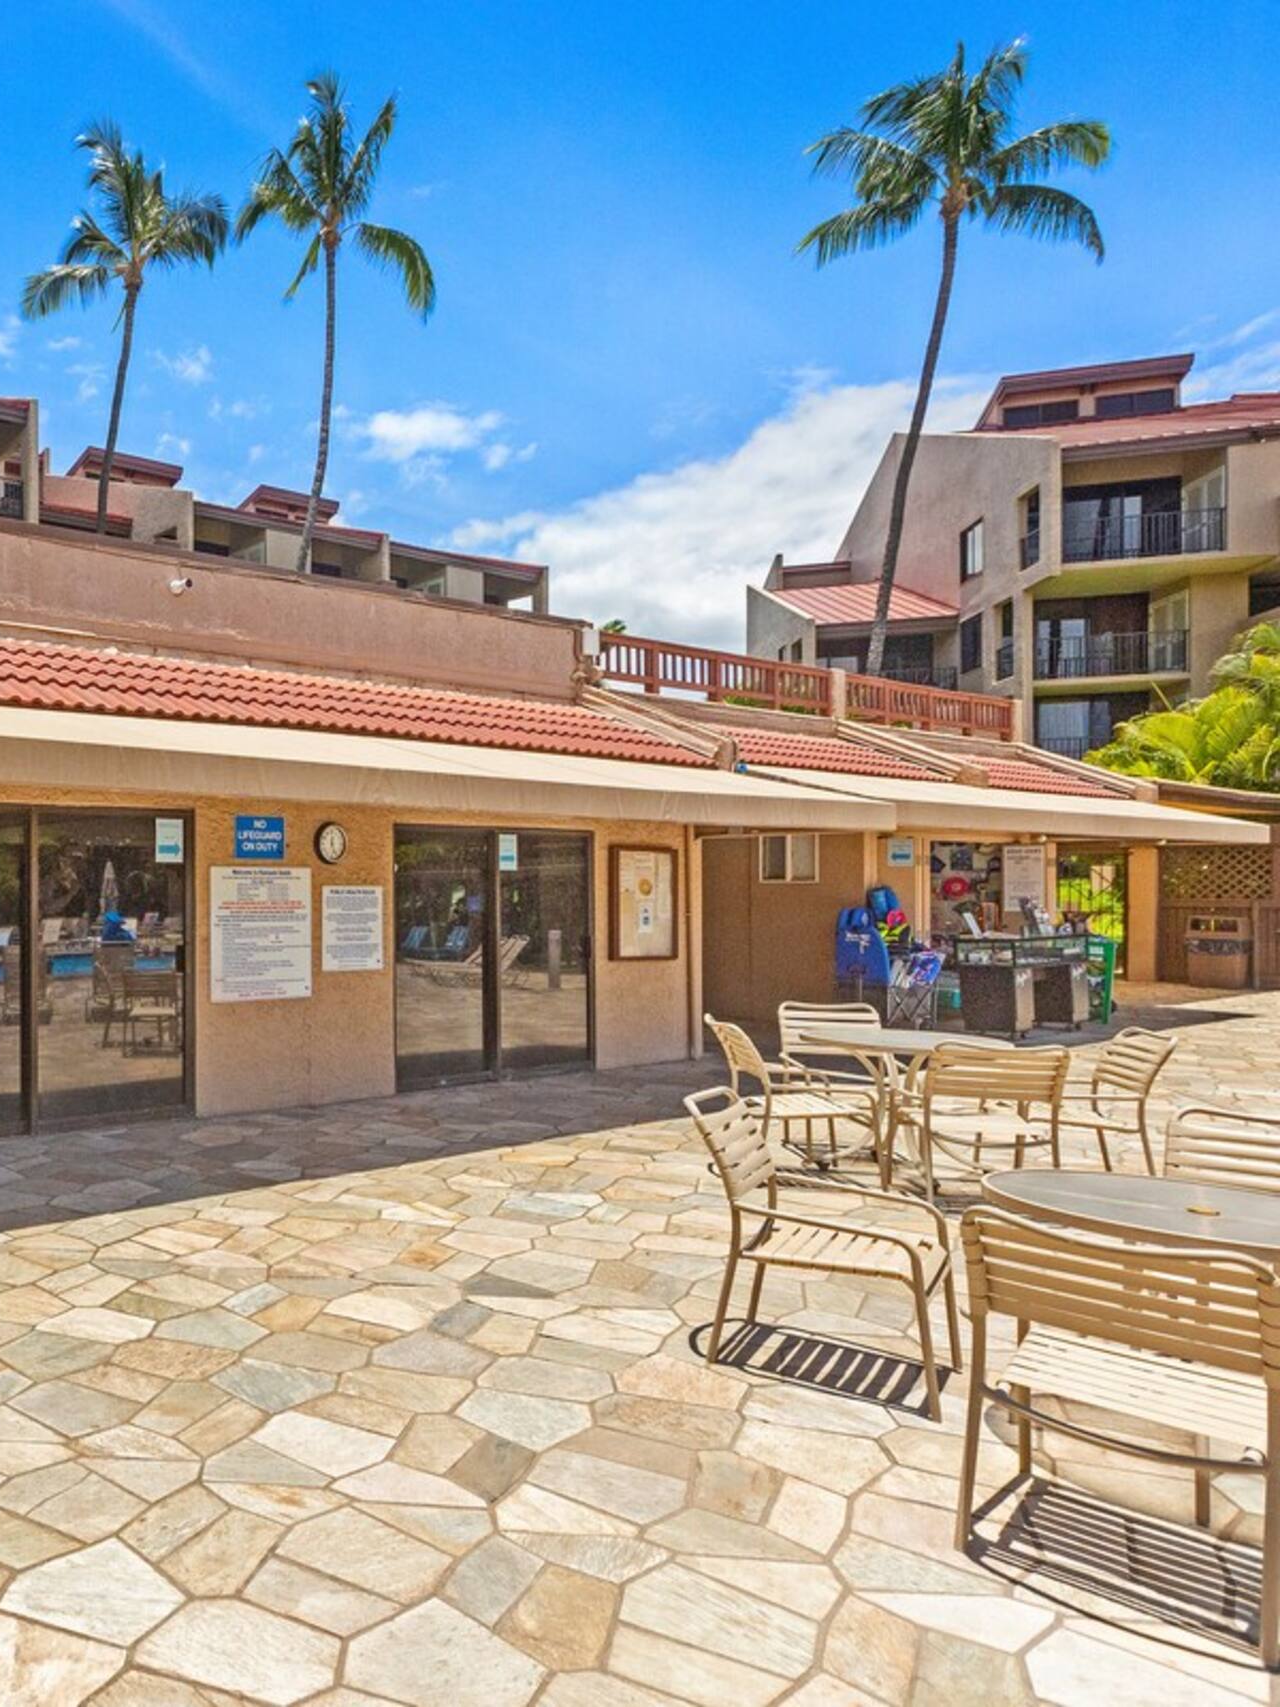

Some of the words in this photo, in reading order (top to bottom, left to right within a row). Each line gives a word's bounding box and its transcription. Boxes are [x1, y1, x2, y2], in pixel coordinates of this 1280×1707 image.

[253, 819, 268, 829] NO
[238, 830, 283, 841] LIFEGUARD
[241, 842, 255, 852] ON
[255, 842, 278, 852] DUTY
